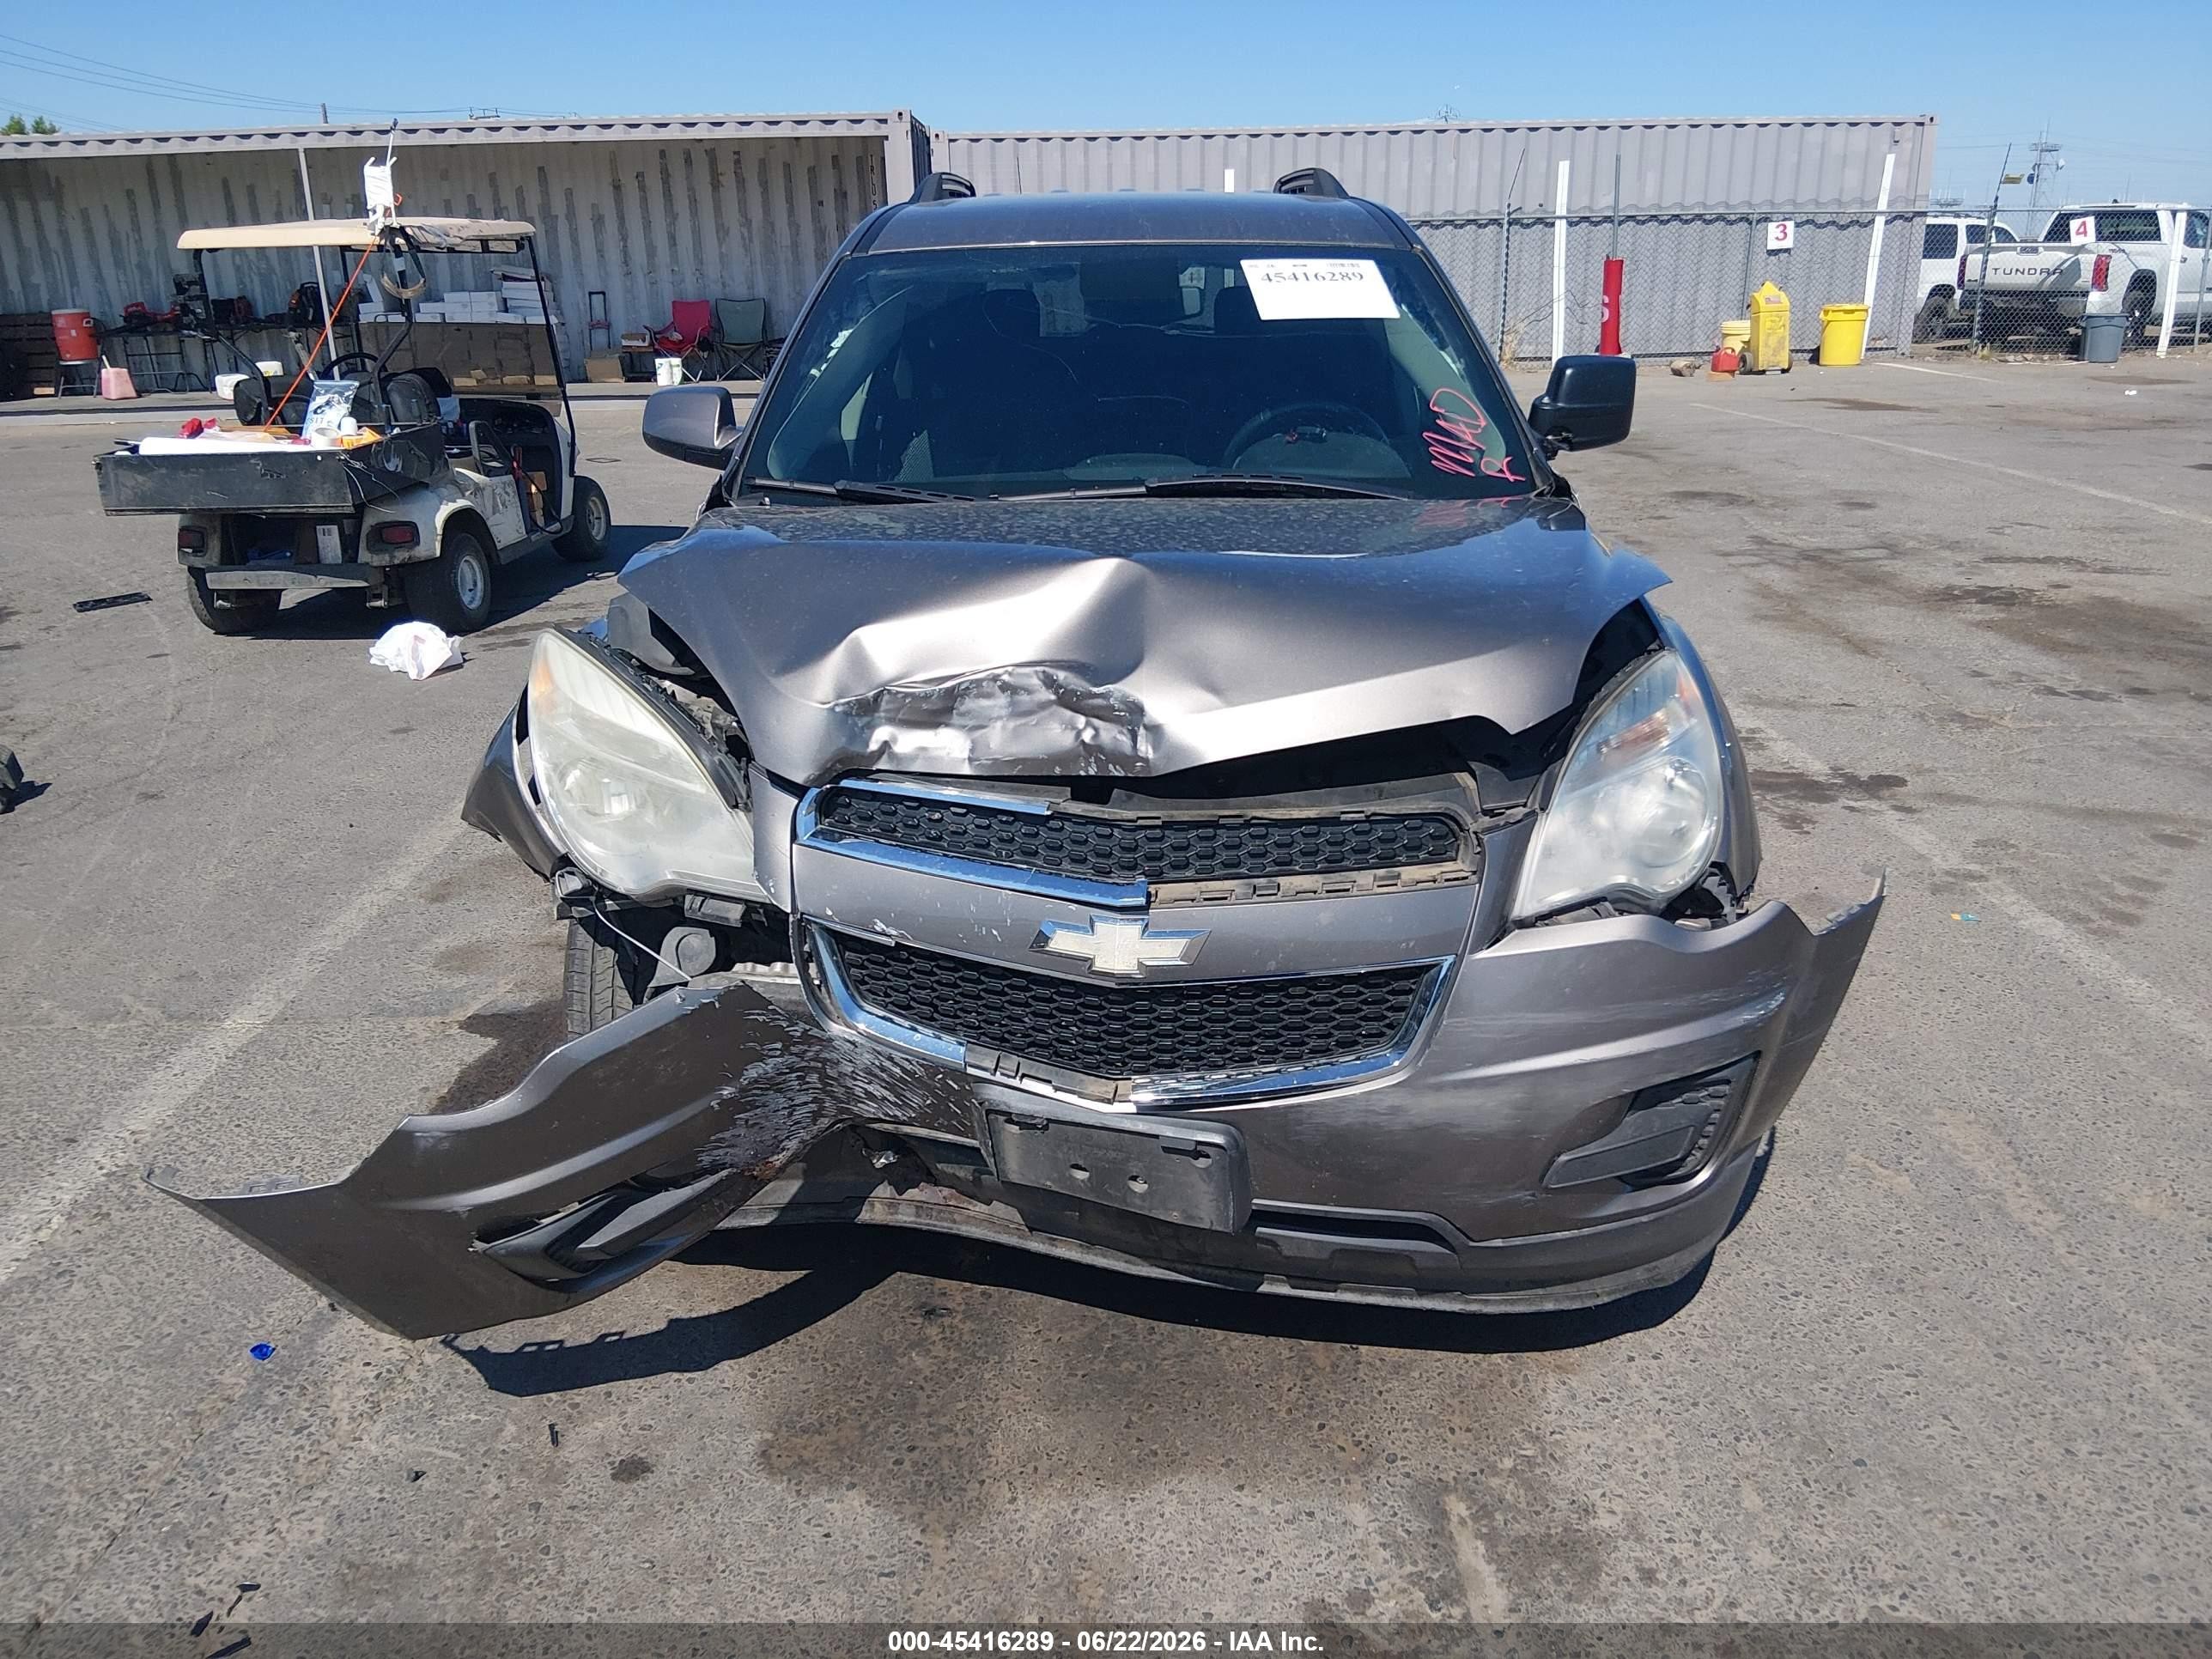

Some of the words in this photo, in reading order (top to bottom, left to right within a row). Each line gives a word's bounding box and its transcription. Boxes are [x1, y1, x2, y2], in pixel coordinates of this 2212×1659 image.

[1774, 223, 1788, 241] 3
[2075, 220, 2087, 237] 4
[1261, 271, 1364, 283] 45416289
[1992, 267, 2063, 276] TUNDRA
